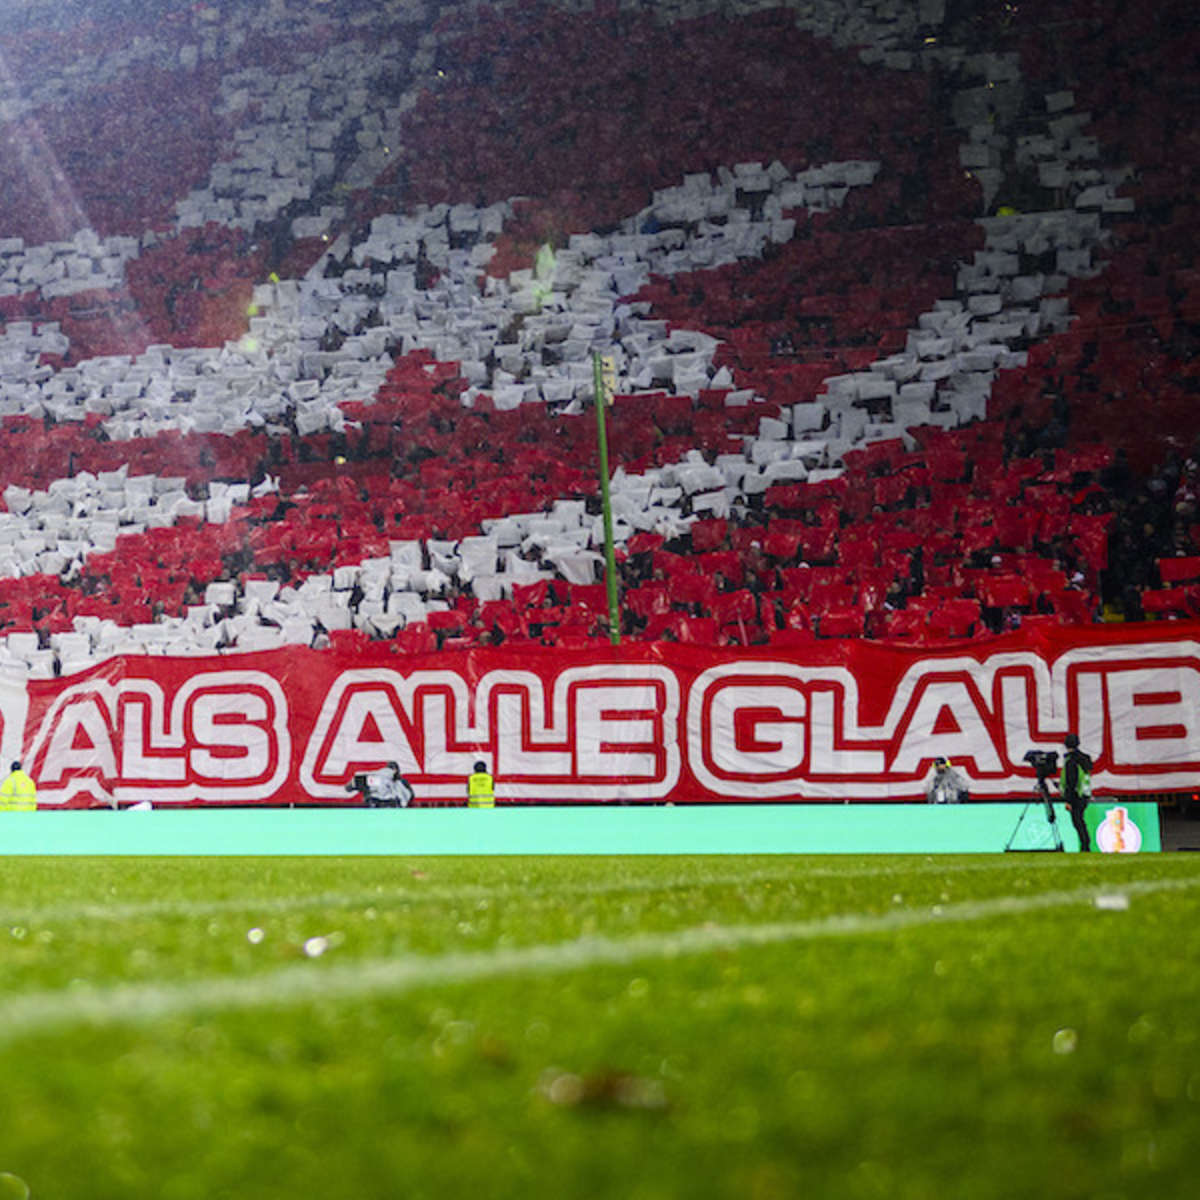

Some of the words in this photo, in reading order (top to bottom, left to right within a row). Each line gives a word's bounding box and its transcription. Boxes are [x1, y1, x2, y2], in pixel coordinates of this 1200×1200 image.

[31, 680, 278, 790] ALS
[311, 675, 667, 787] ALLE
[701, 653, 1200, 786] GLAUB
